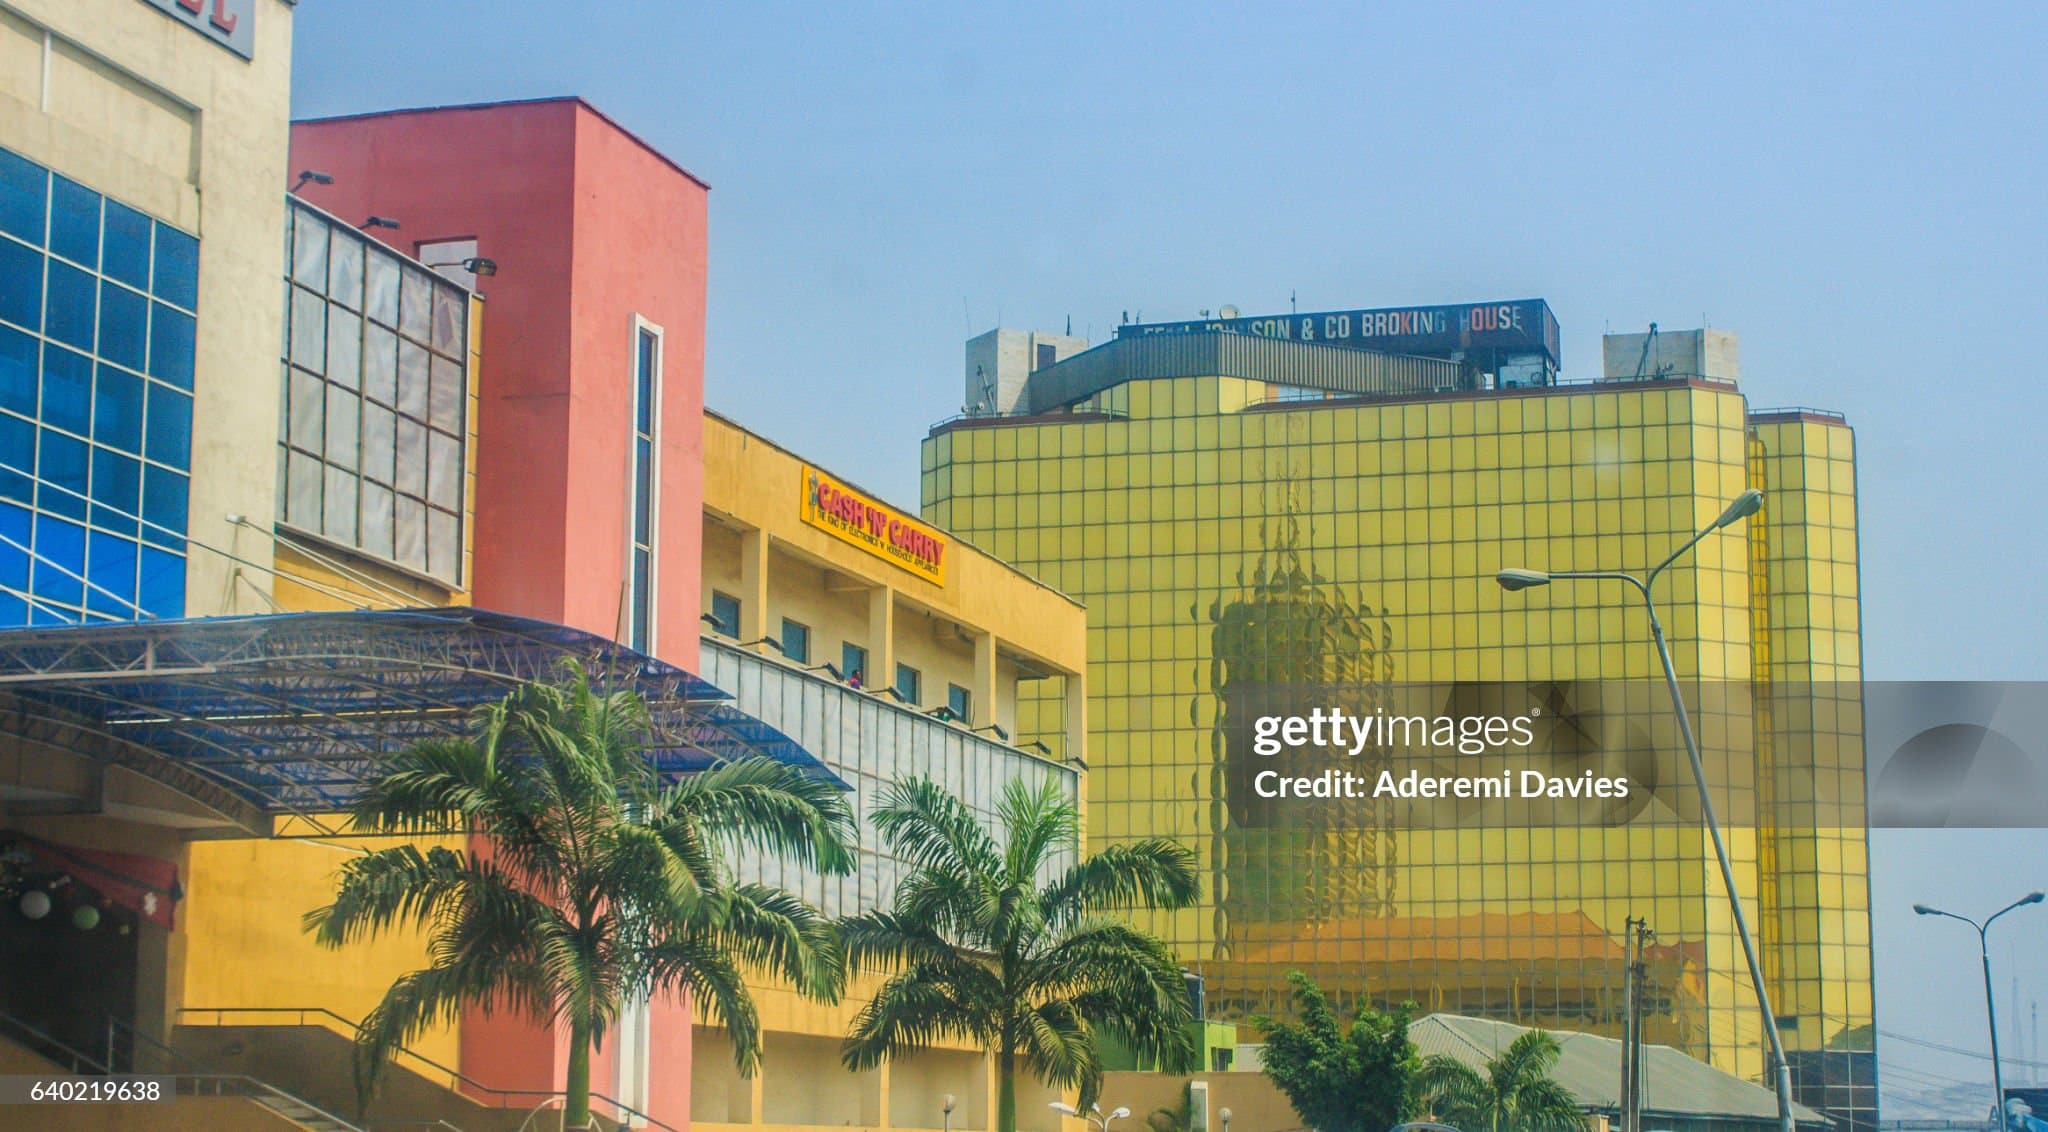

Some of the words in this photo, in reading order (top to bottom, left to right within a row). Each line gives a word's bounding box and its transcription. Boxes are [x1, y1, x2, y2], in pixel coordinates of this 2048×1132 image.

[1301, 318, 1314, 341] &
[1325, 315, 1350, 339] CO
[1362, 310, 1446, 337] BROKING
[1460, 305, 1522, 332] HOUSE
[817, 483, 864, 529] CASH
[889, 519, 944, 566] CARRY
